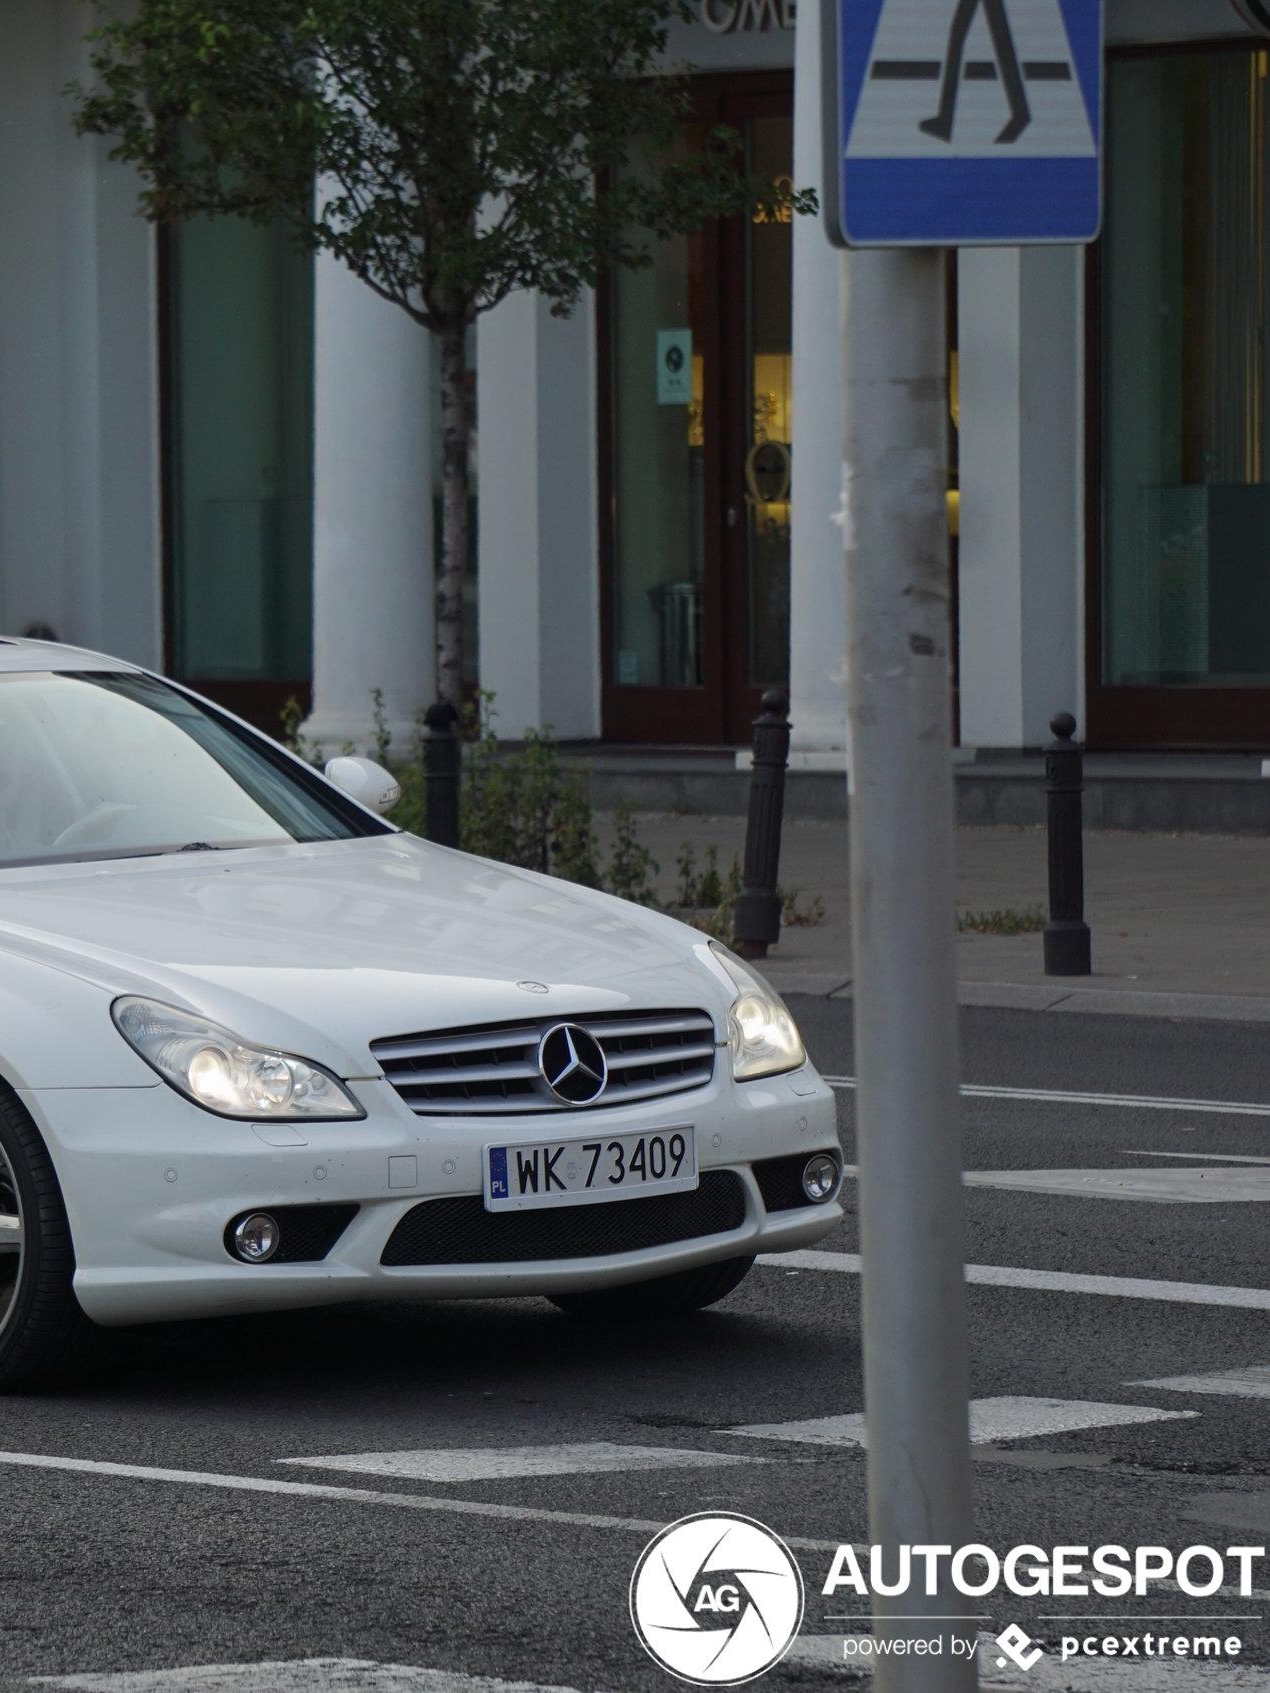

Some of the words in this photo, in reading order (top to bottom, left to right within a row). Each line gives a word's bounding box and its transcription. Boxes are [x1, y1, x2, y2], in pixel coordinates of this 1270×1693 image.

[516, 1146, 567, 1194] WK
[582, 1133, 685, 1188] 73409
[492, 1180, 506, 1193] PL
